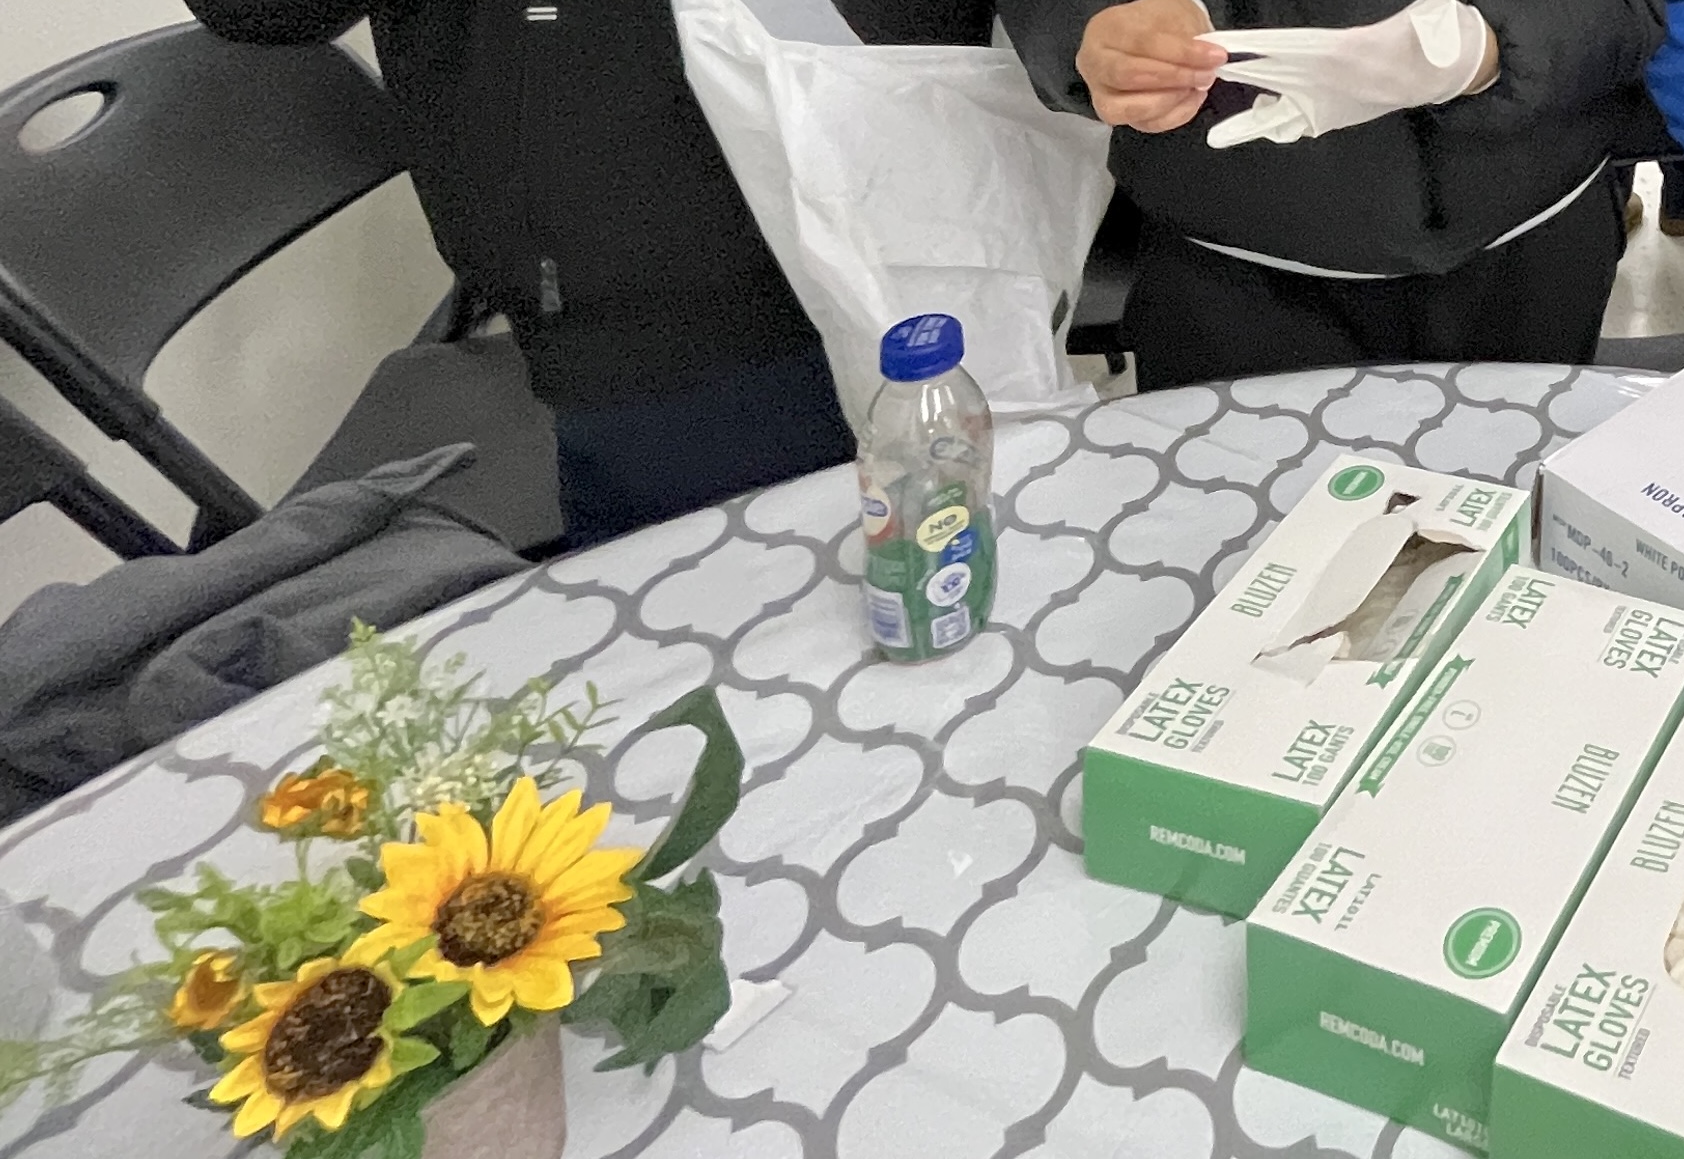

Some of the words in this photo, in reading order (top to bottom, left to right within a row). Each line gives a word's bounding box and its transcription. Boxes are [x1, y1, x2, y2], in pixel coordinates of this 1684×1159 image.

[928, 512, 959, 535] NO
[1450, 488, 1498, 527] LATEX
[1635, 538, 1668, 572] WHITE
[1230, 562, 1297, 618] BLUZEN
[1501, 578, 1556, 630] LATEX
[1603, 608, 1654, 670] GLOVES
[1128, 677, 1204, 742] LATEX
[1163, 684, 1230, 749] GLOVES
[1271, 719, 1337, 783] LATEX
[1302, 760, 1329, 786] 100
[1319, 725, 1355, 764] GANTS
[1551, 743, 1620, 814] BLUZEN
[1291, 846, 1366, 924] LATEX
[1540, 963, 1617, 1059] LATEX
[1582, 974, 1650, 1072] GLOVES
